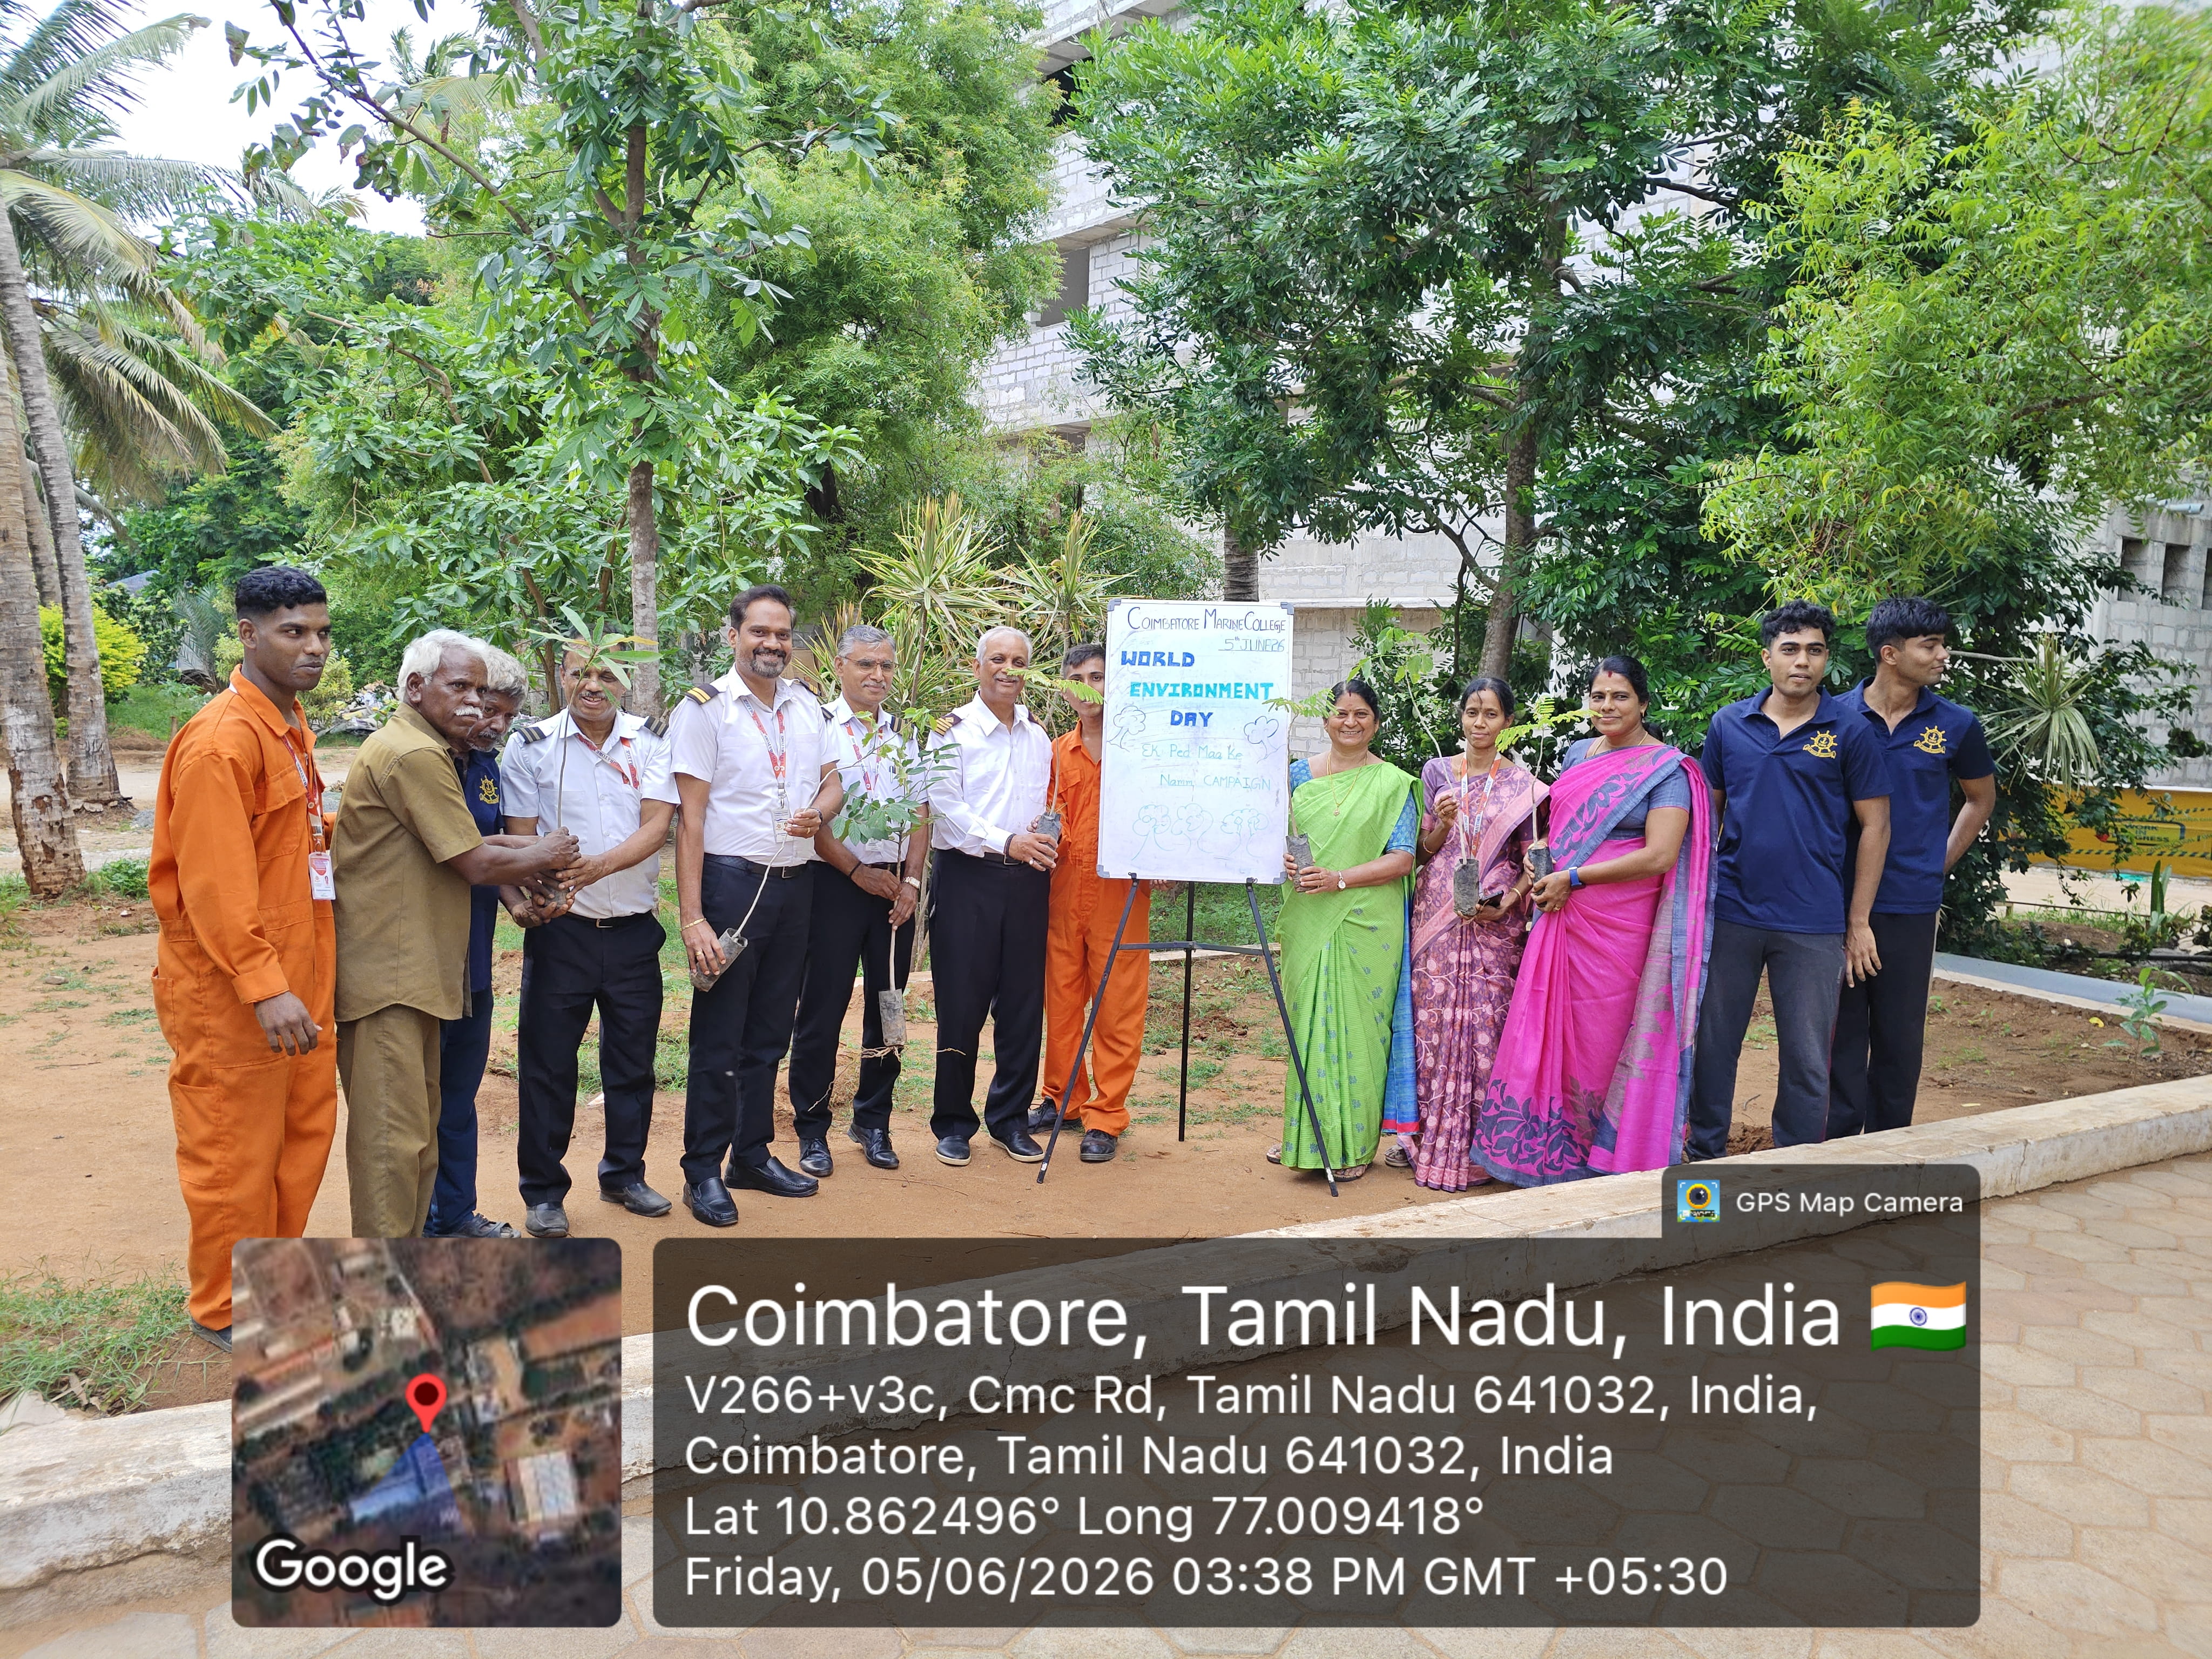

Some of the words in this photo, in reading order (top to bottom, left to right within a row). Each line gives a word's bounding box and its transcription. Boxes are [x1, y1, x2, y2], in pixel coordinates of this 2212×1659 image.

[1128, 606, 1199, 630] COIMBATORE
[1204, 609, 1244, 630] MARINE
[1245, 611, 1286, 633] COLLEGE
[1121, 651, 1195, 667] WORLD
[1129, 682, 1274, 700] ENVIRONMENT
[1170, 710, 1213, 727] DAY
[1204, 775, 1271, 791] CAMPAIGN
